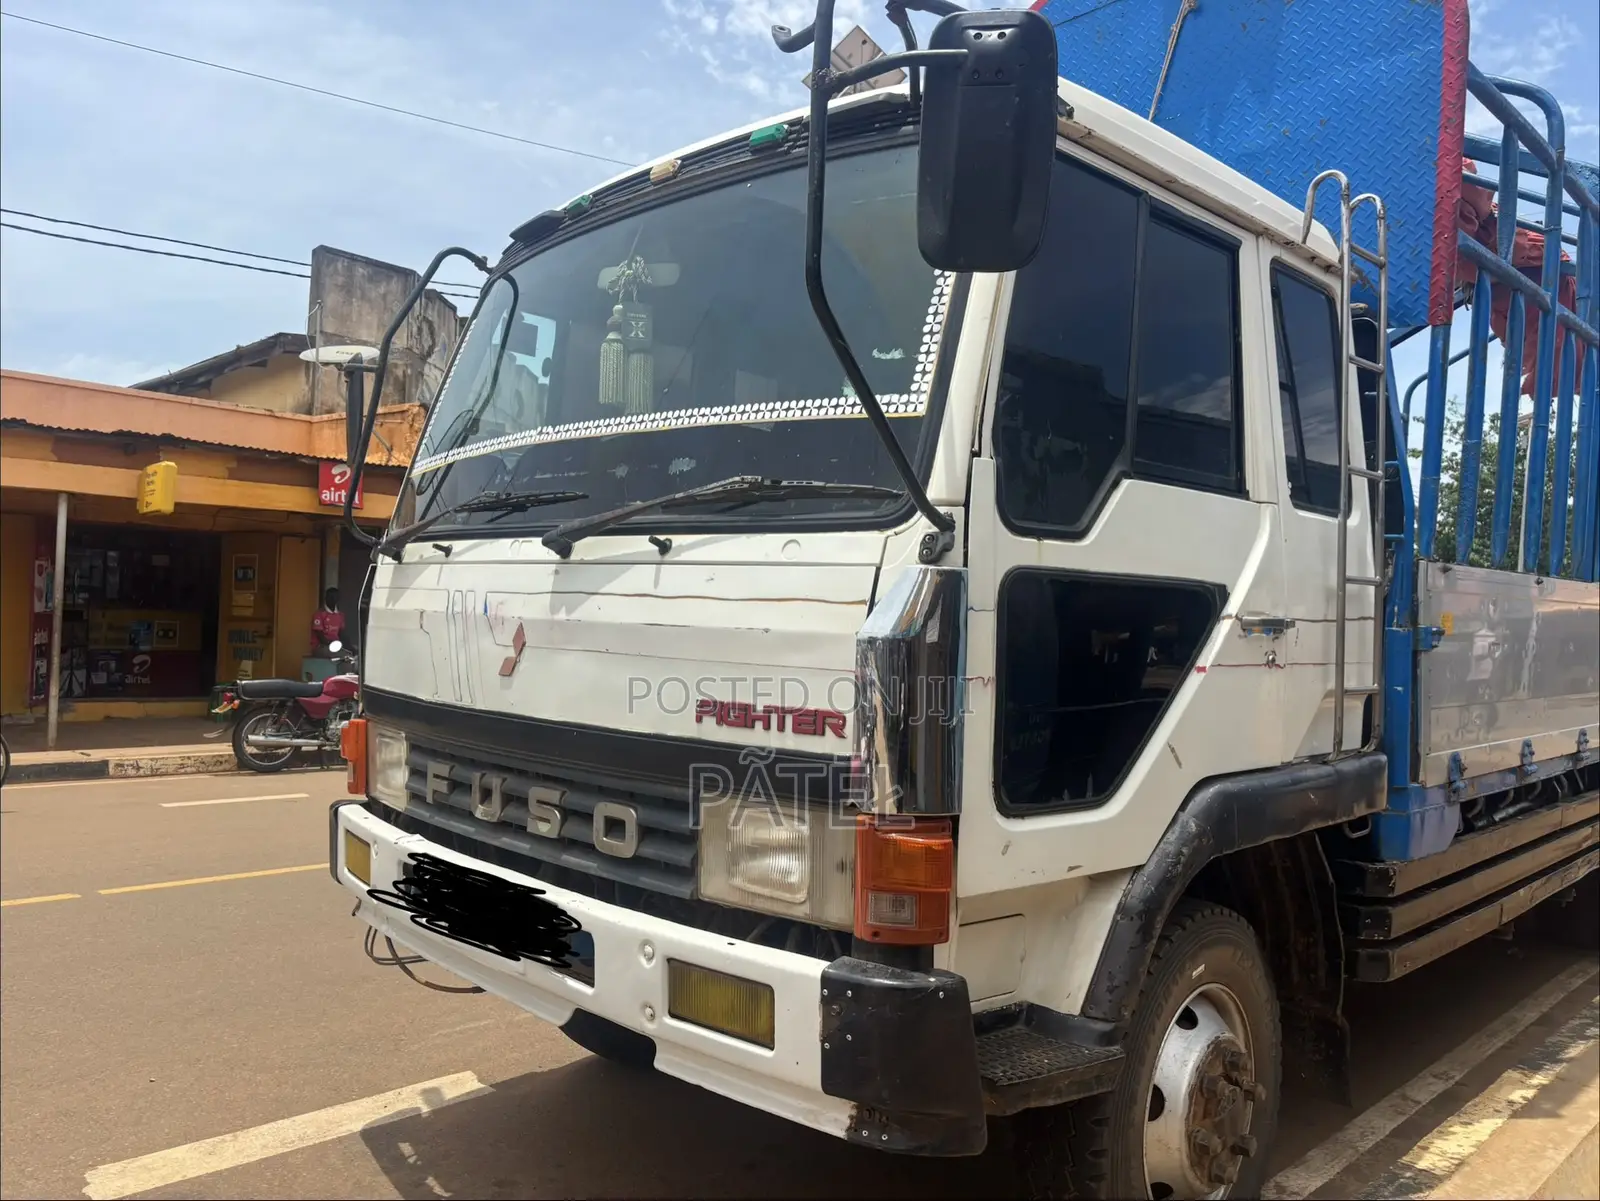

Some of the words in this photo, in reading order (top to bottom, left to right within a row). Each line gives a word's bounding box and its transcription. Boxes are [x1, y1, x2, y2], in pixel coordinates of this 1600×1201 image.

[321, 486, 359, 504] airtl
[124, 674, 152, 685] airtel
[695, 698, 848, 739] FIGHTER
[426, 761, 640, 859] FUSO
